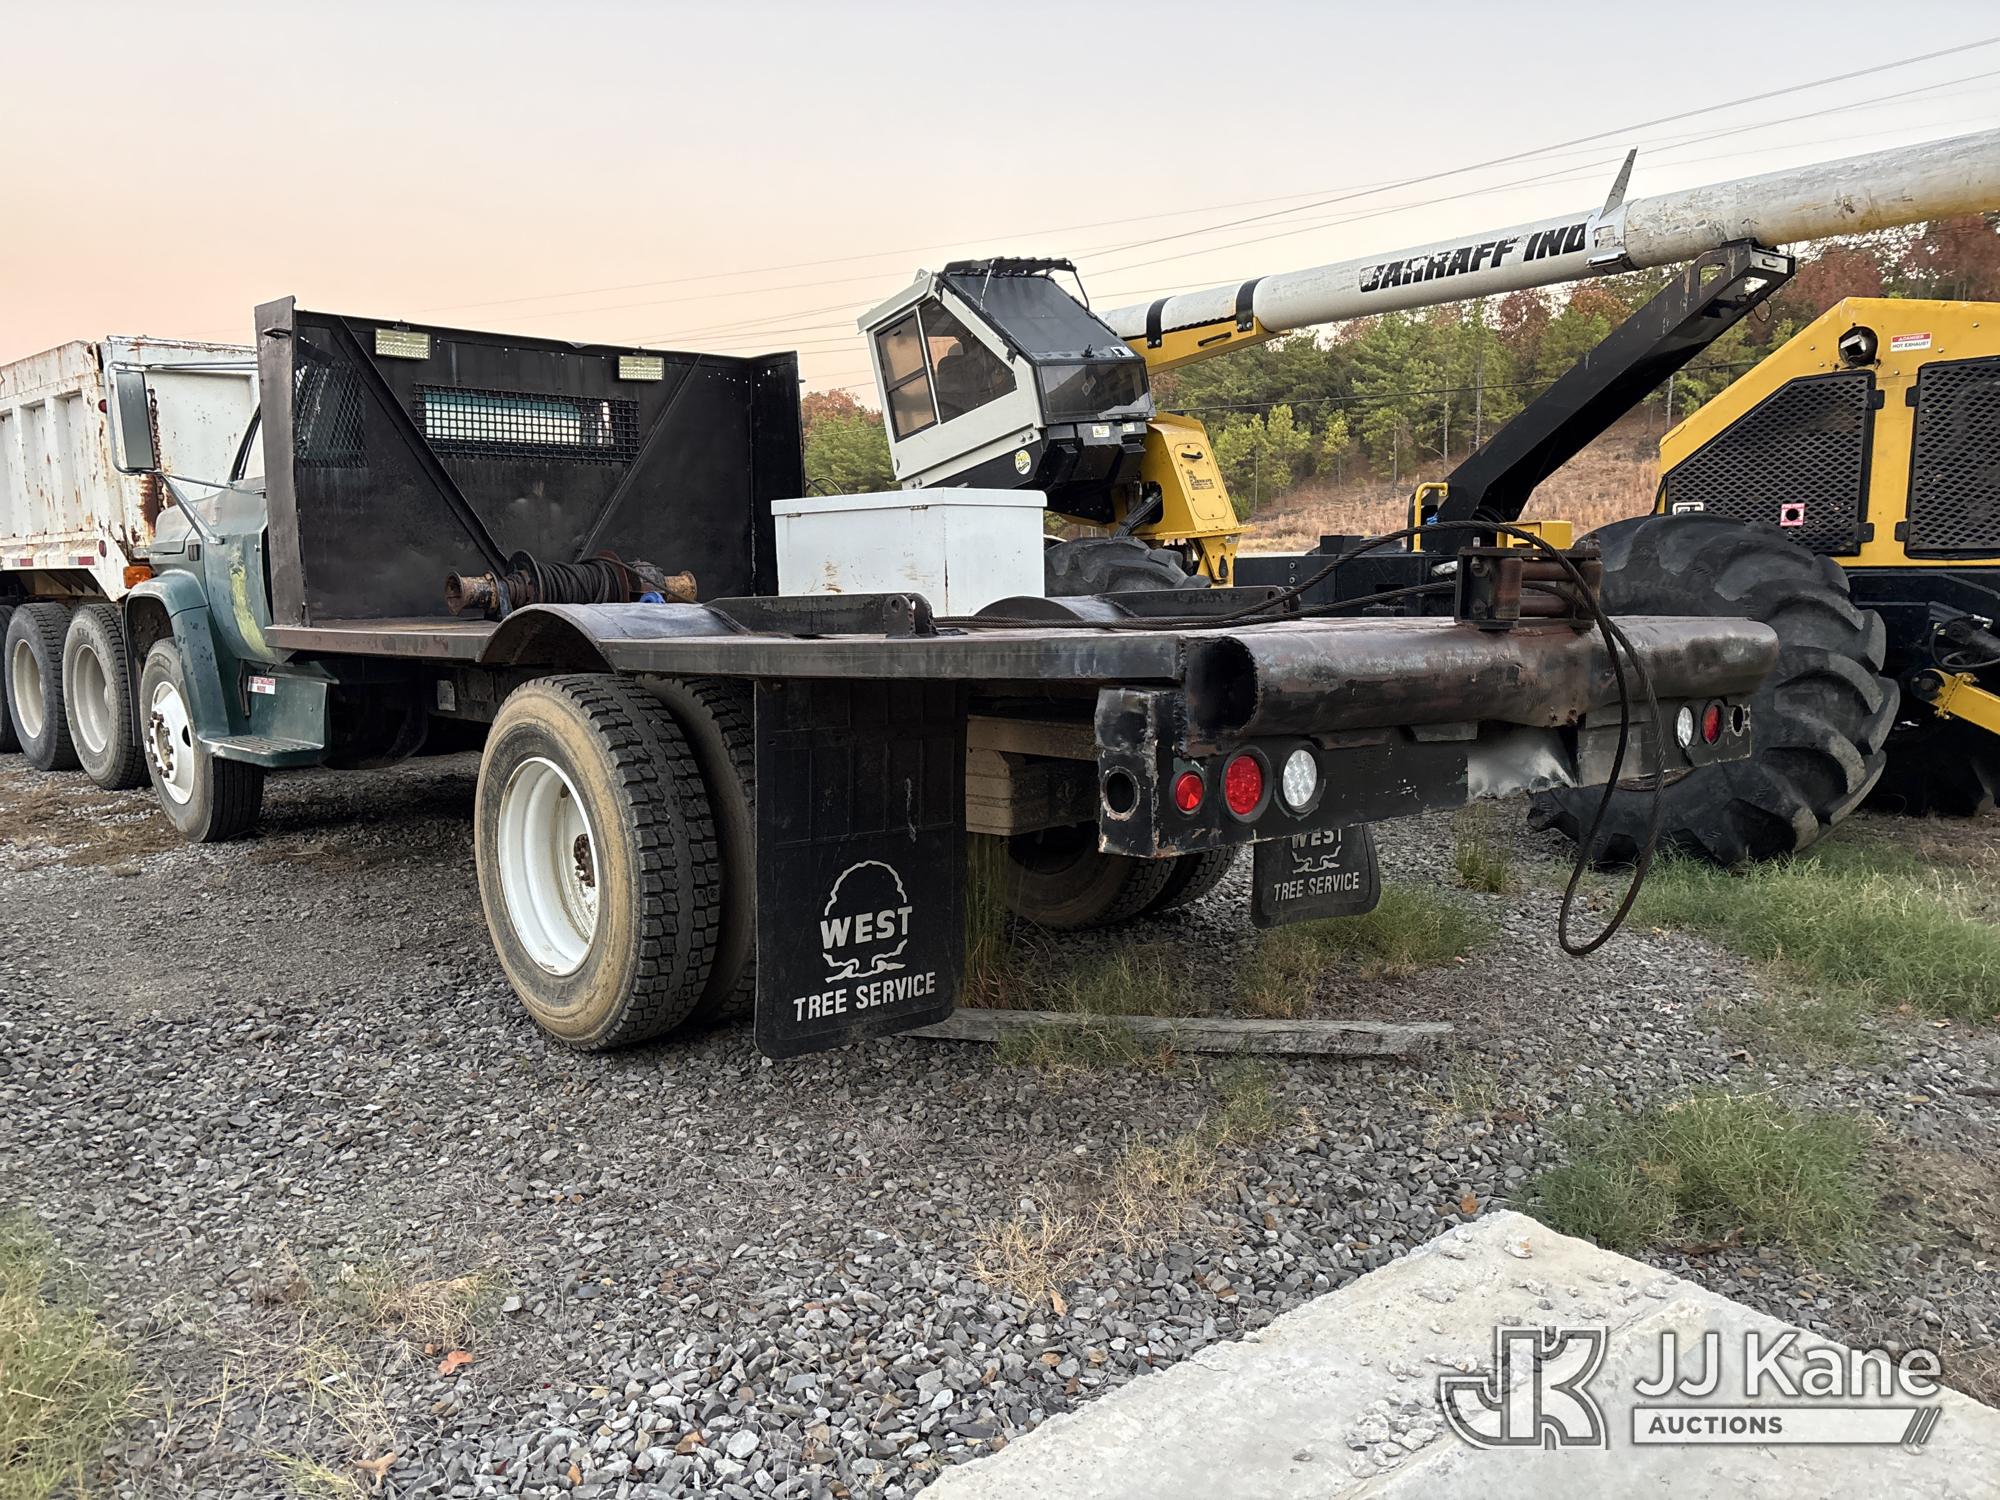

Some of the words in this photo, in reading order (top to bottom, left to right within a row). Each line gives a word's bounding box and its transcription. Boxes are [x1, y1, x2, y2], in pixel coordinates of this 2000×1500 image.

[1273, 879, 1304, 902] TREE
[1307, 871, 1360, 897] SERVICE
[819, 905, 913, 950] WEST
[793, 988, 847, 1022] TREE
[855, 971, 936, 1010] SERVICE
